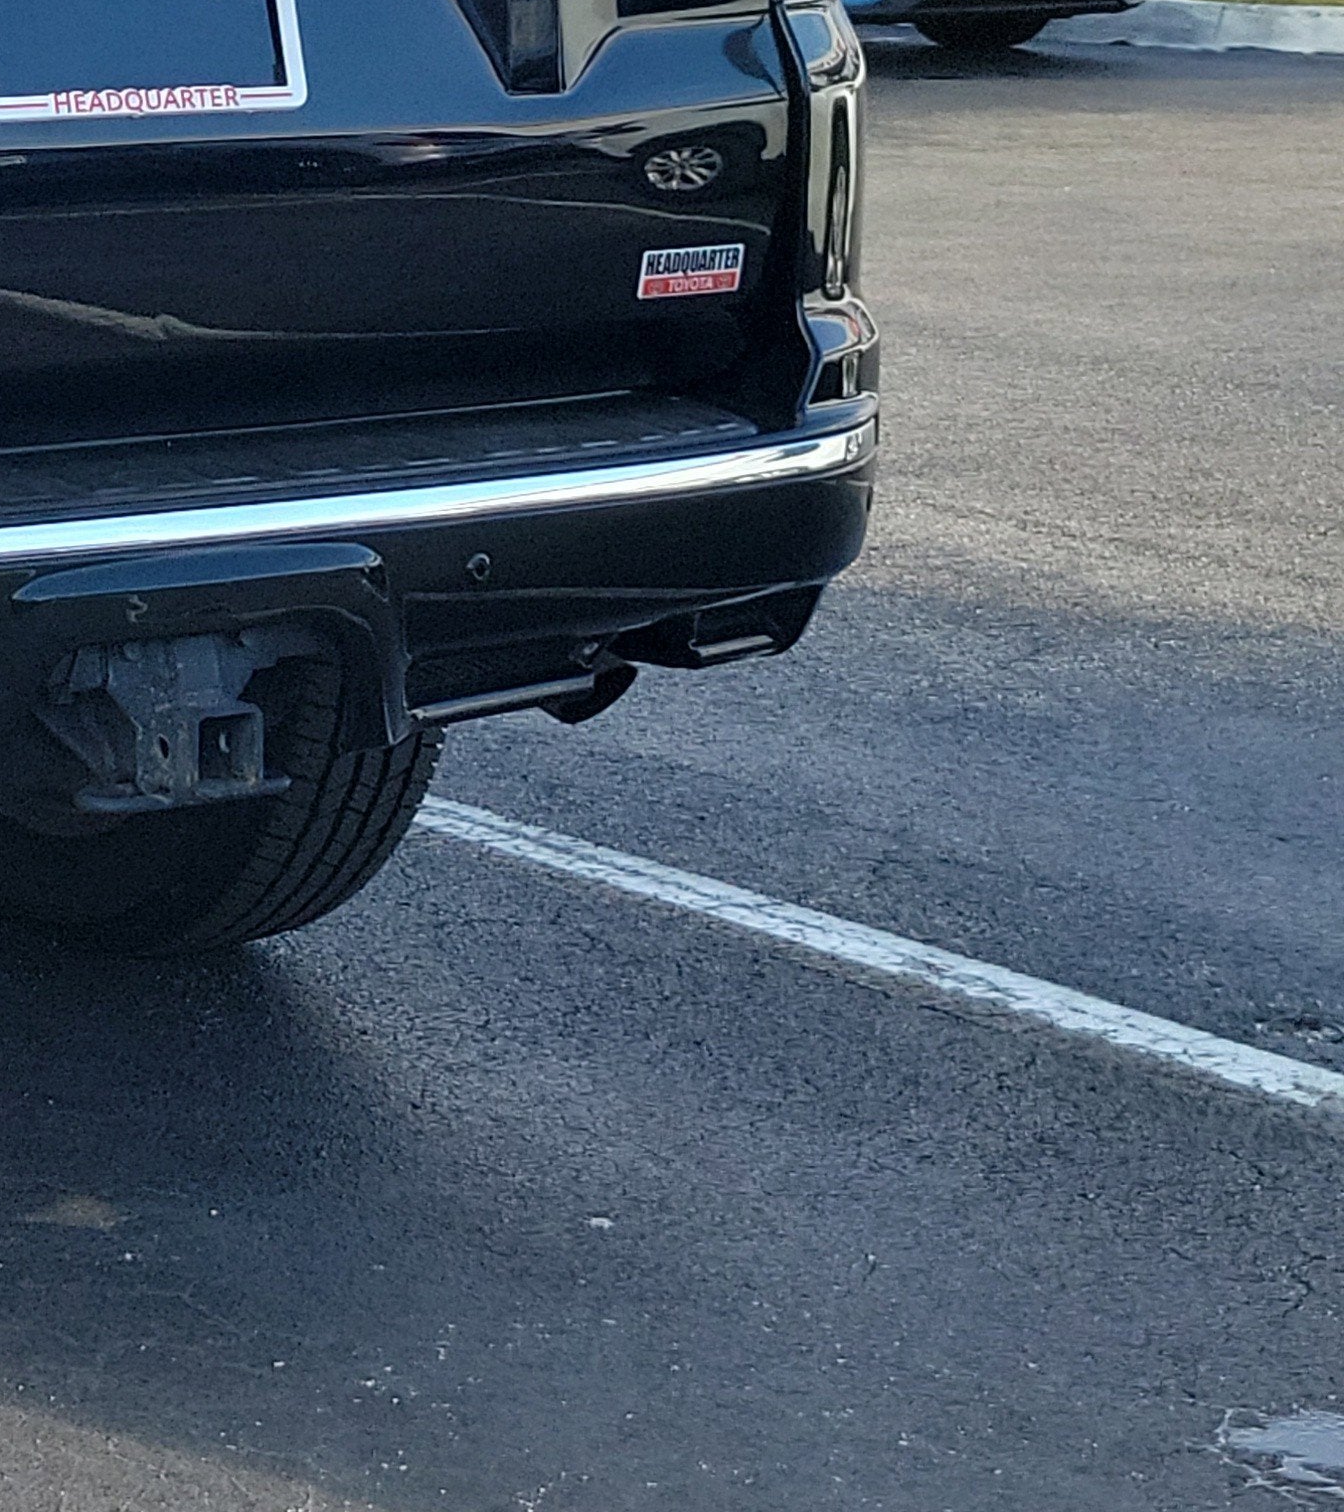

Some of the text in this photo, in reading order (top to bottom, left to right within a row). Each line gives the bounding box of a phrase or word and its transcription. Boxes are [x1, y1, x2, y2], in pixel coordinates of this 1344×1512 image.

[53, 87, 240, 113] HEADQUARTER
[645, 247, 740, 275] HEADQUARTER
[668, 276, 713, 292] TOYOTA
